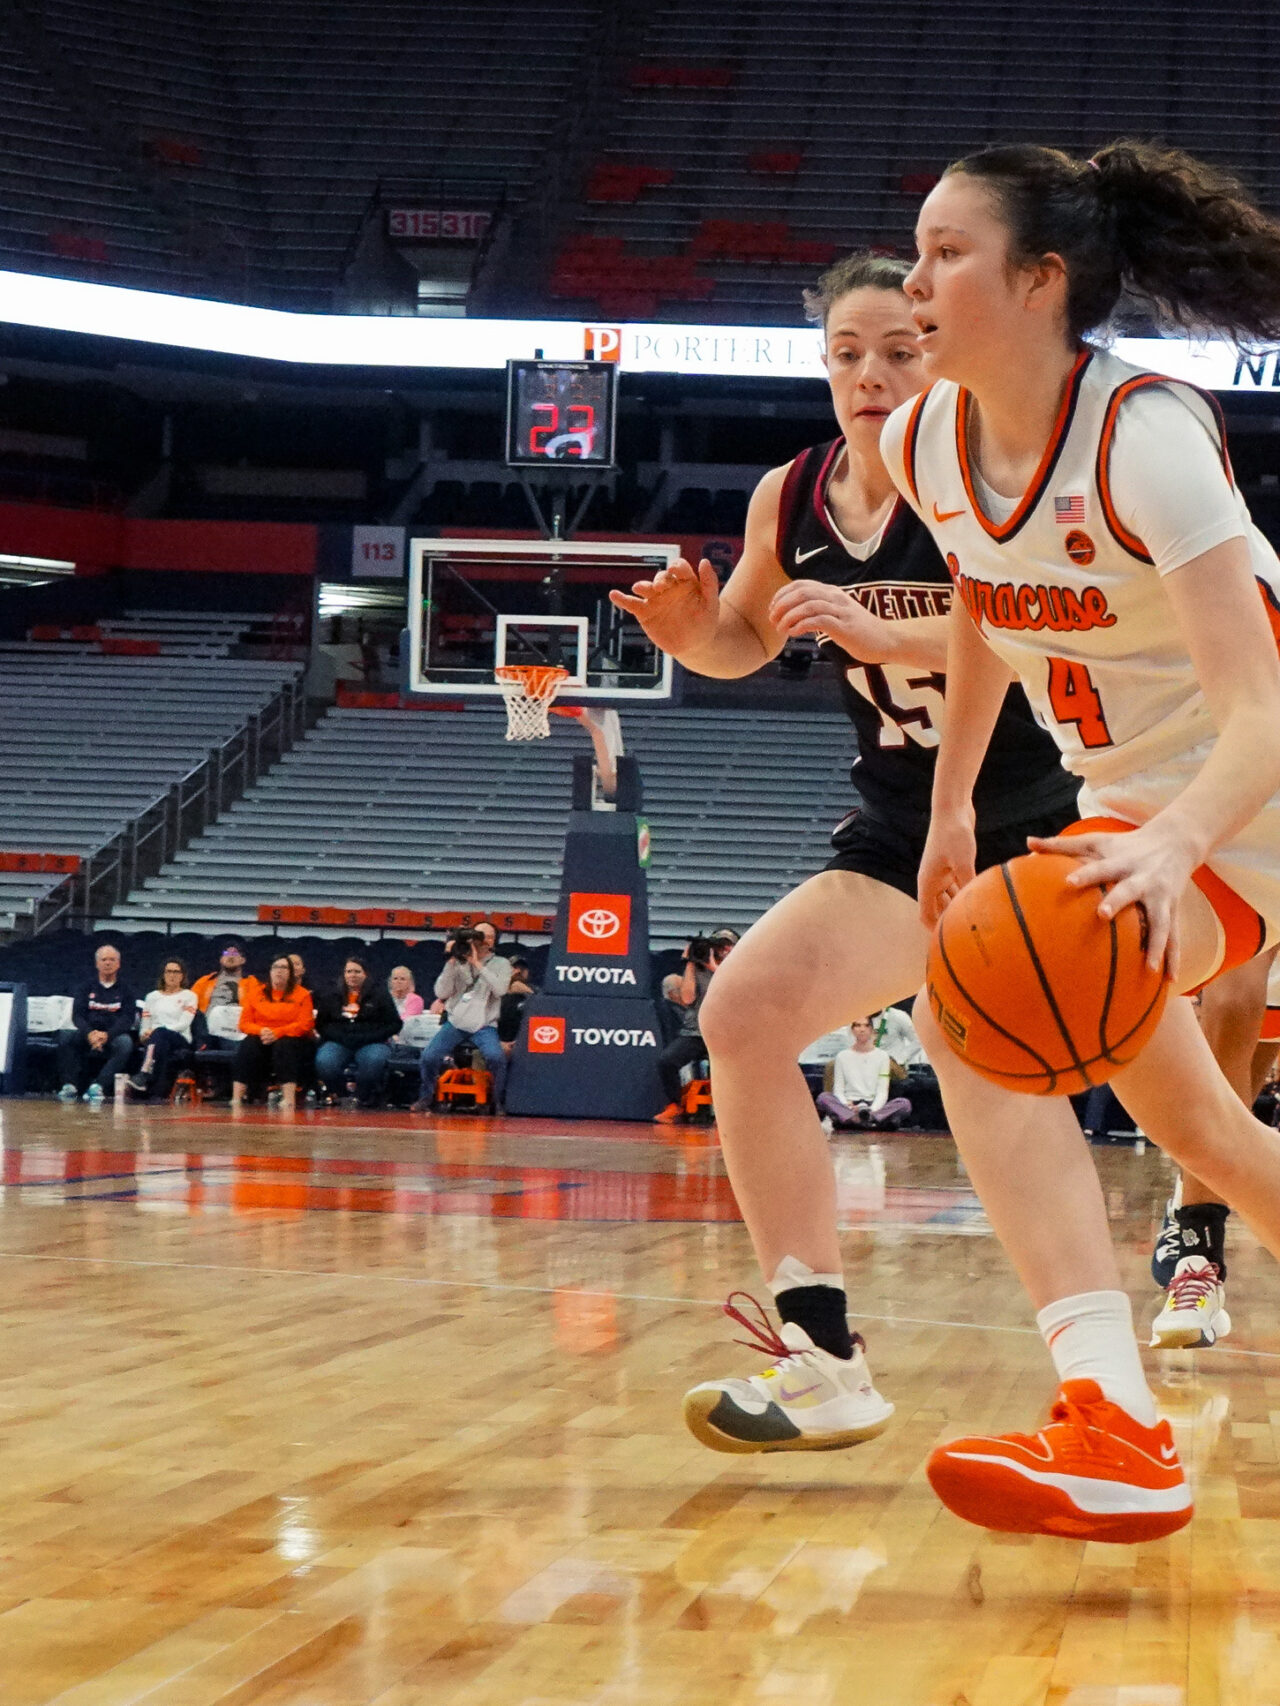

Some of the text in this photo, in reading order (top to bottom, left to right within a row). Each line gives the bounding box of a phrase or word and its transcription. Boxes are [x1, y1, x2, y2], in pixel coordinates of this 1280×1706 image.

[391, 212, 439, 234] 315
[635, 334, 773, 364] PORTER
[530, 403, 594, 455] 23
[361, 543, 397, 561] 113
[848, 587, 954, 621] YETTE
[846, 664, 944, 748] 15
[1046, 656, 1115, 749] 4
[556, 966, 637, 985] TOYOTA
[571, 1028, 657, 1047] TOYOTA
